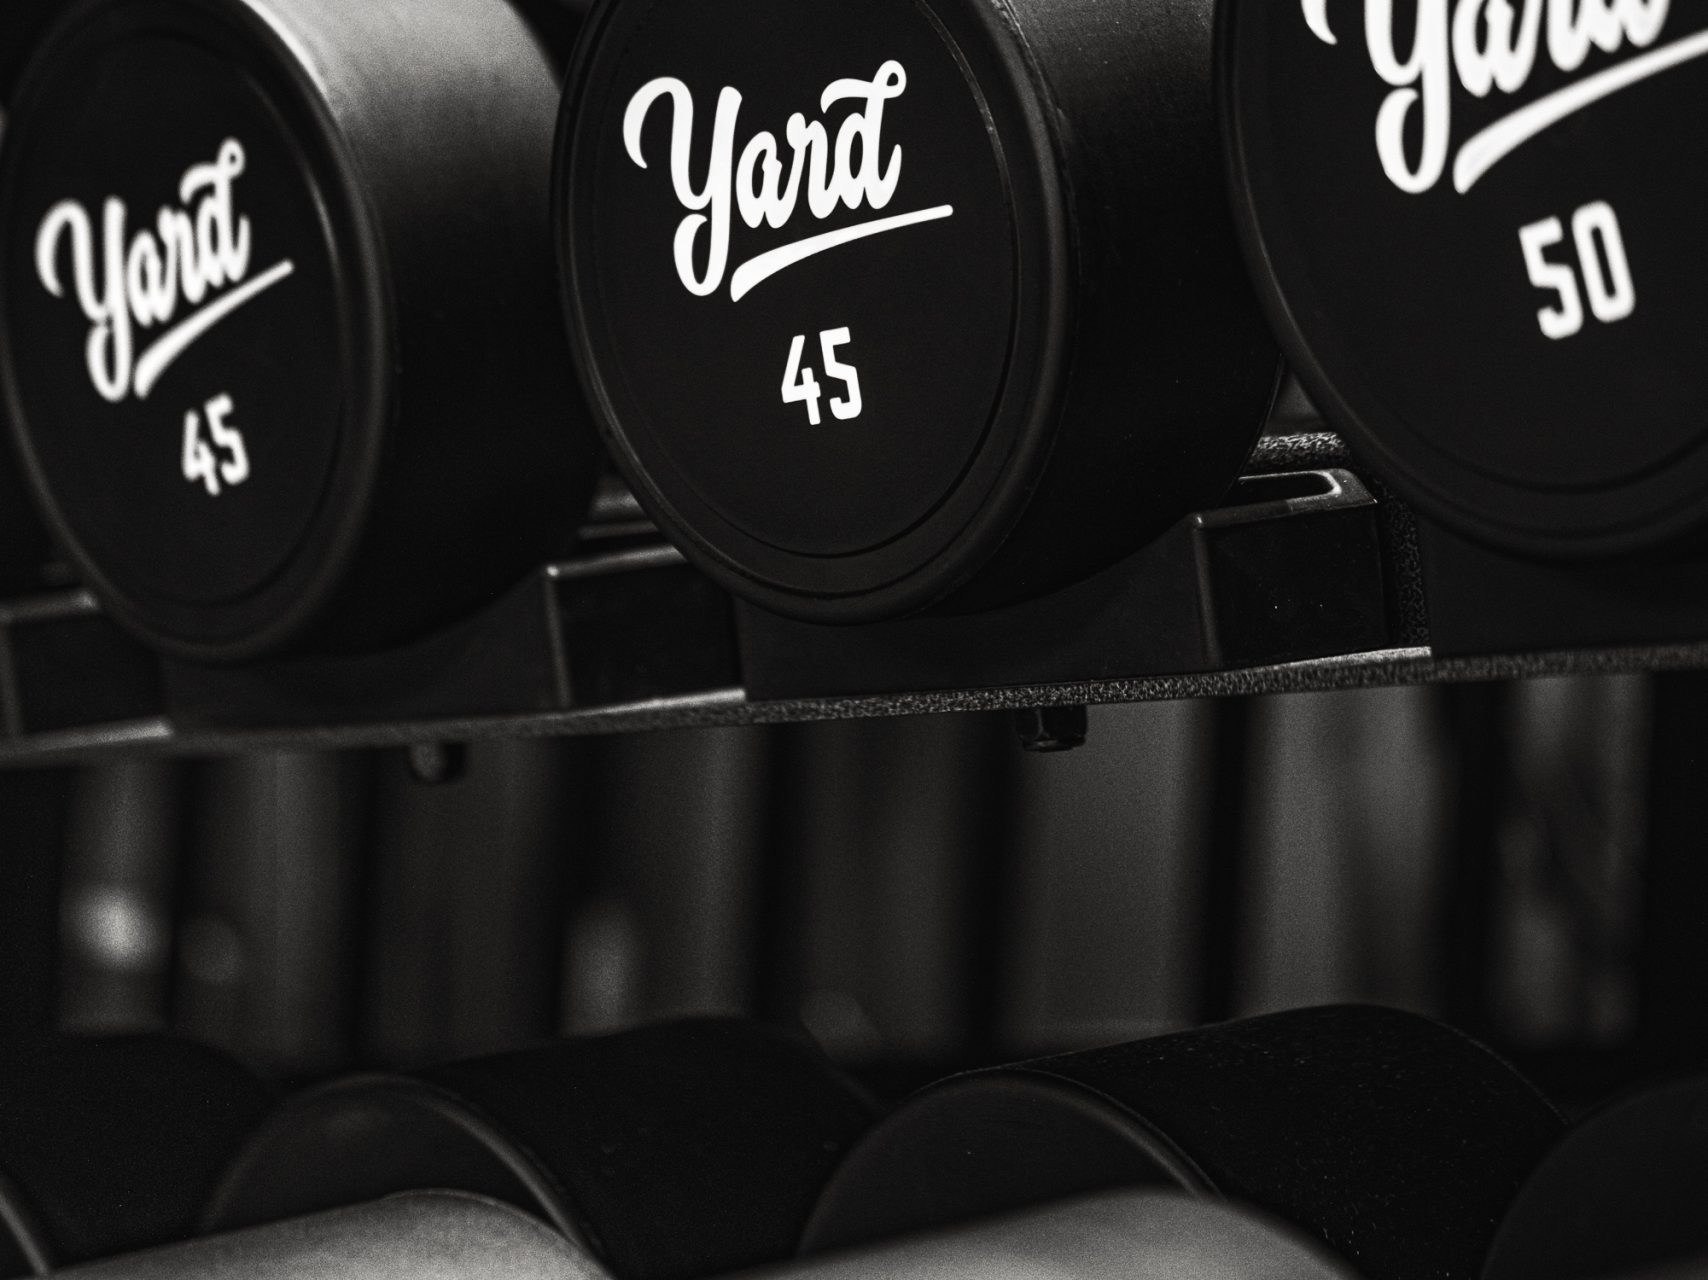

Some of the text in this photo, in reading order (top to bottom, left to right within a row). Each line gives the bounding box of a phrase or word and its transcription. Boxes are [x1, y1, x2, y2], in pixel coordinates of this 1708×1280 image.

[622, 59, 908, 298] Yard
[35, 138, 251, 402] Yard
[1518, 200, 1636, 340] 50
[181, 393, 250, 496] 45
[780, 326, 863, 426] 45
